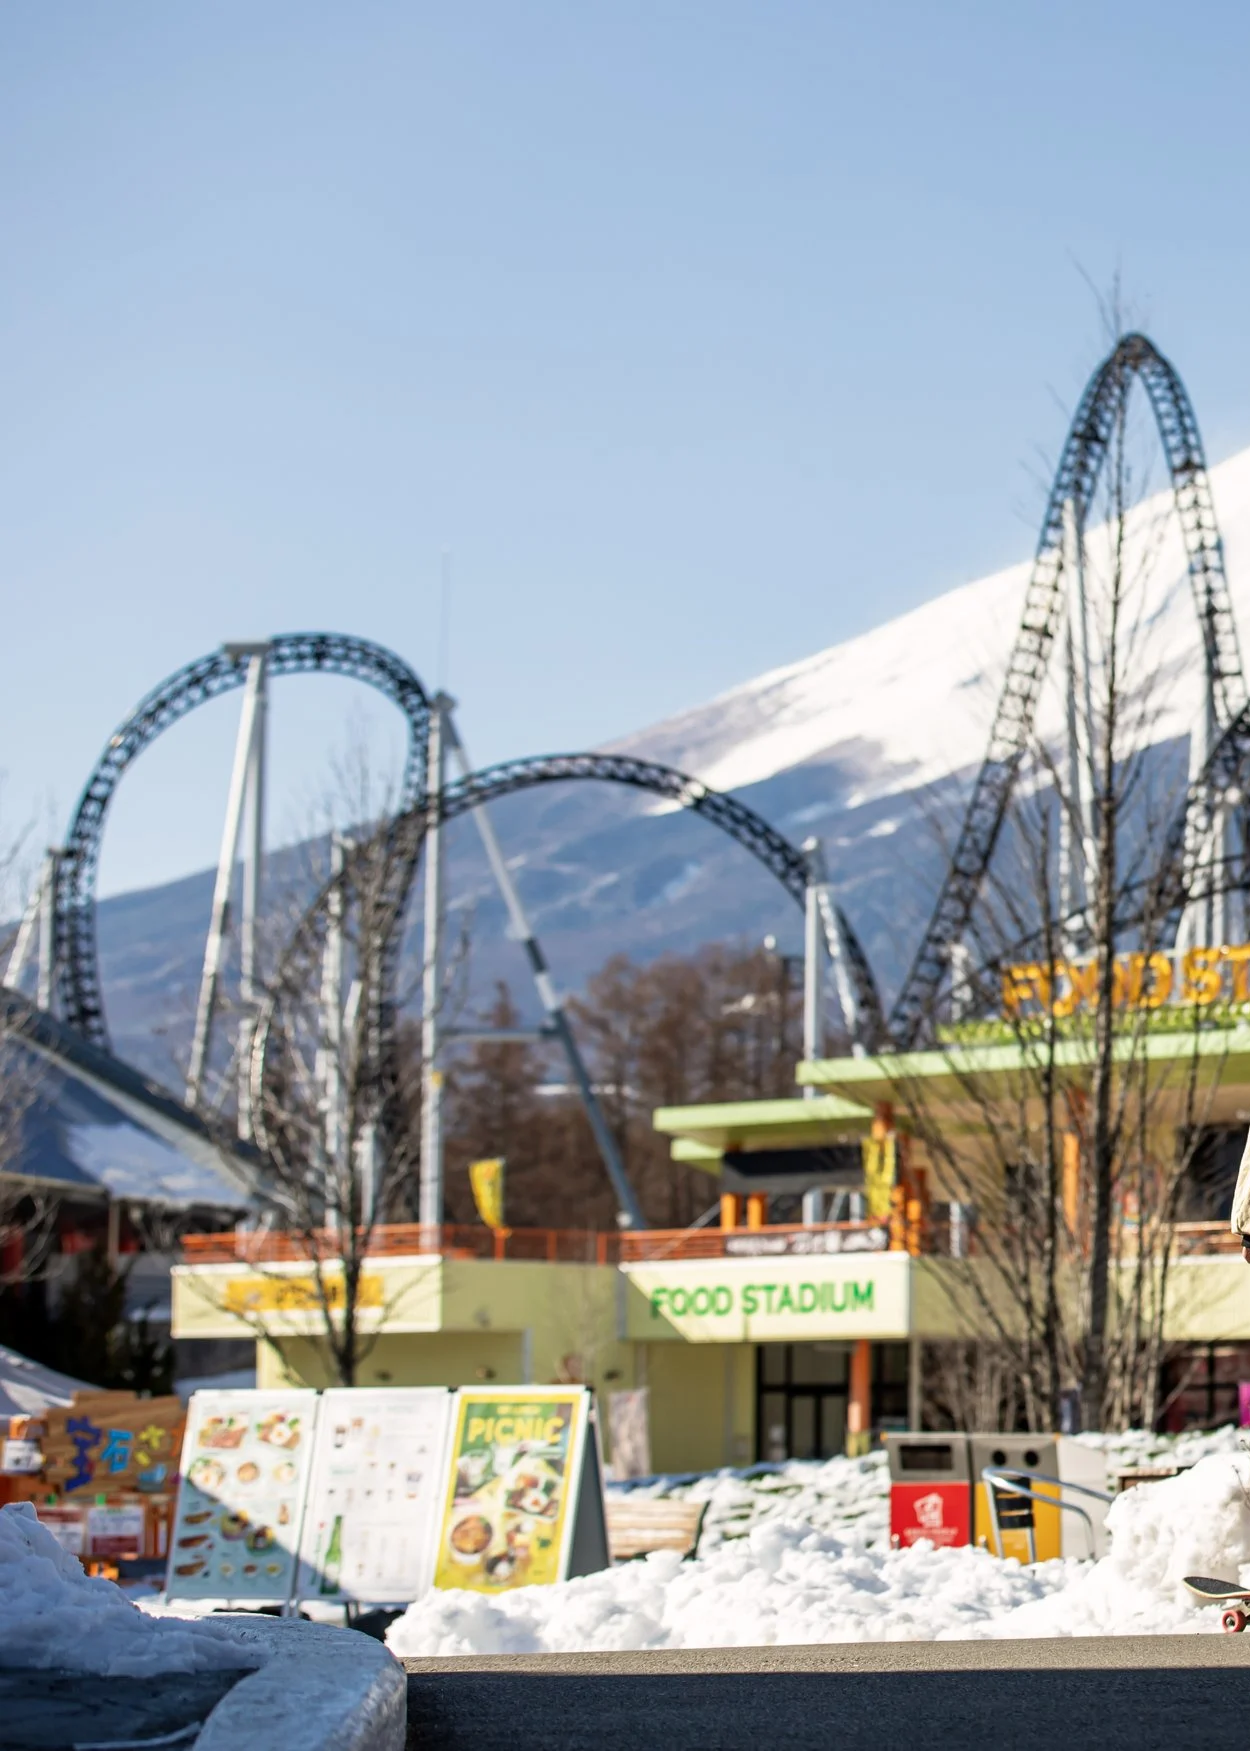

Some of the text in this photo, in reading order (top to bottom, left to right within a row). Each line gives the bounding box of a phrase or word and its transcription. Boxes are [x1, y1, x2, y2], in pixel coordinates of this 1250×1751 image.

[651, 1280, 875, 1319] FOOD STADIUM
[466, 1415, 565, 1444] PICNIC
